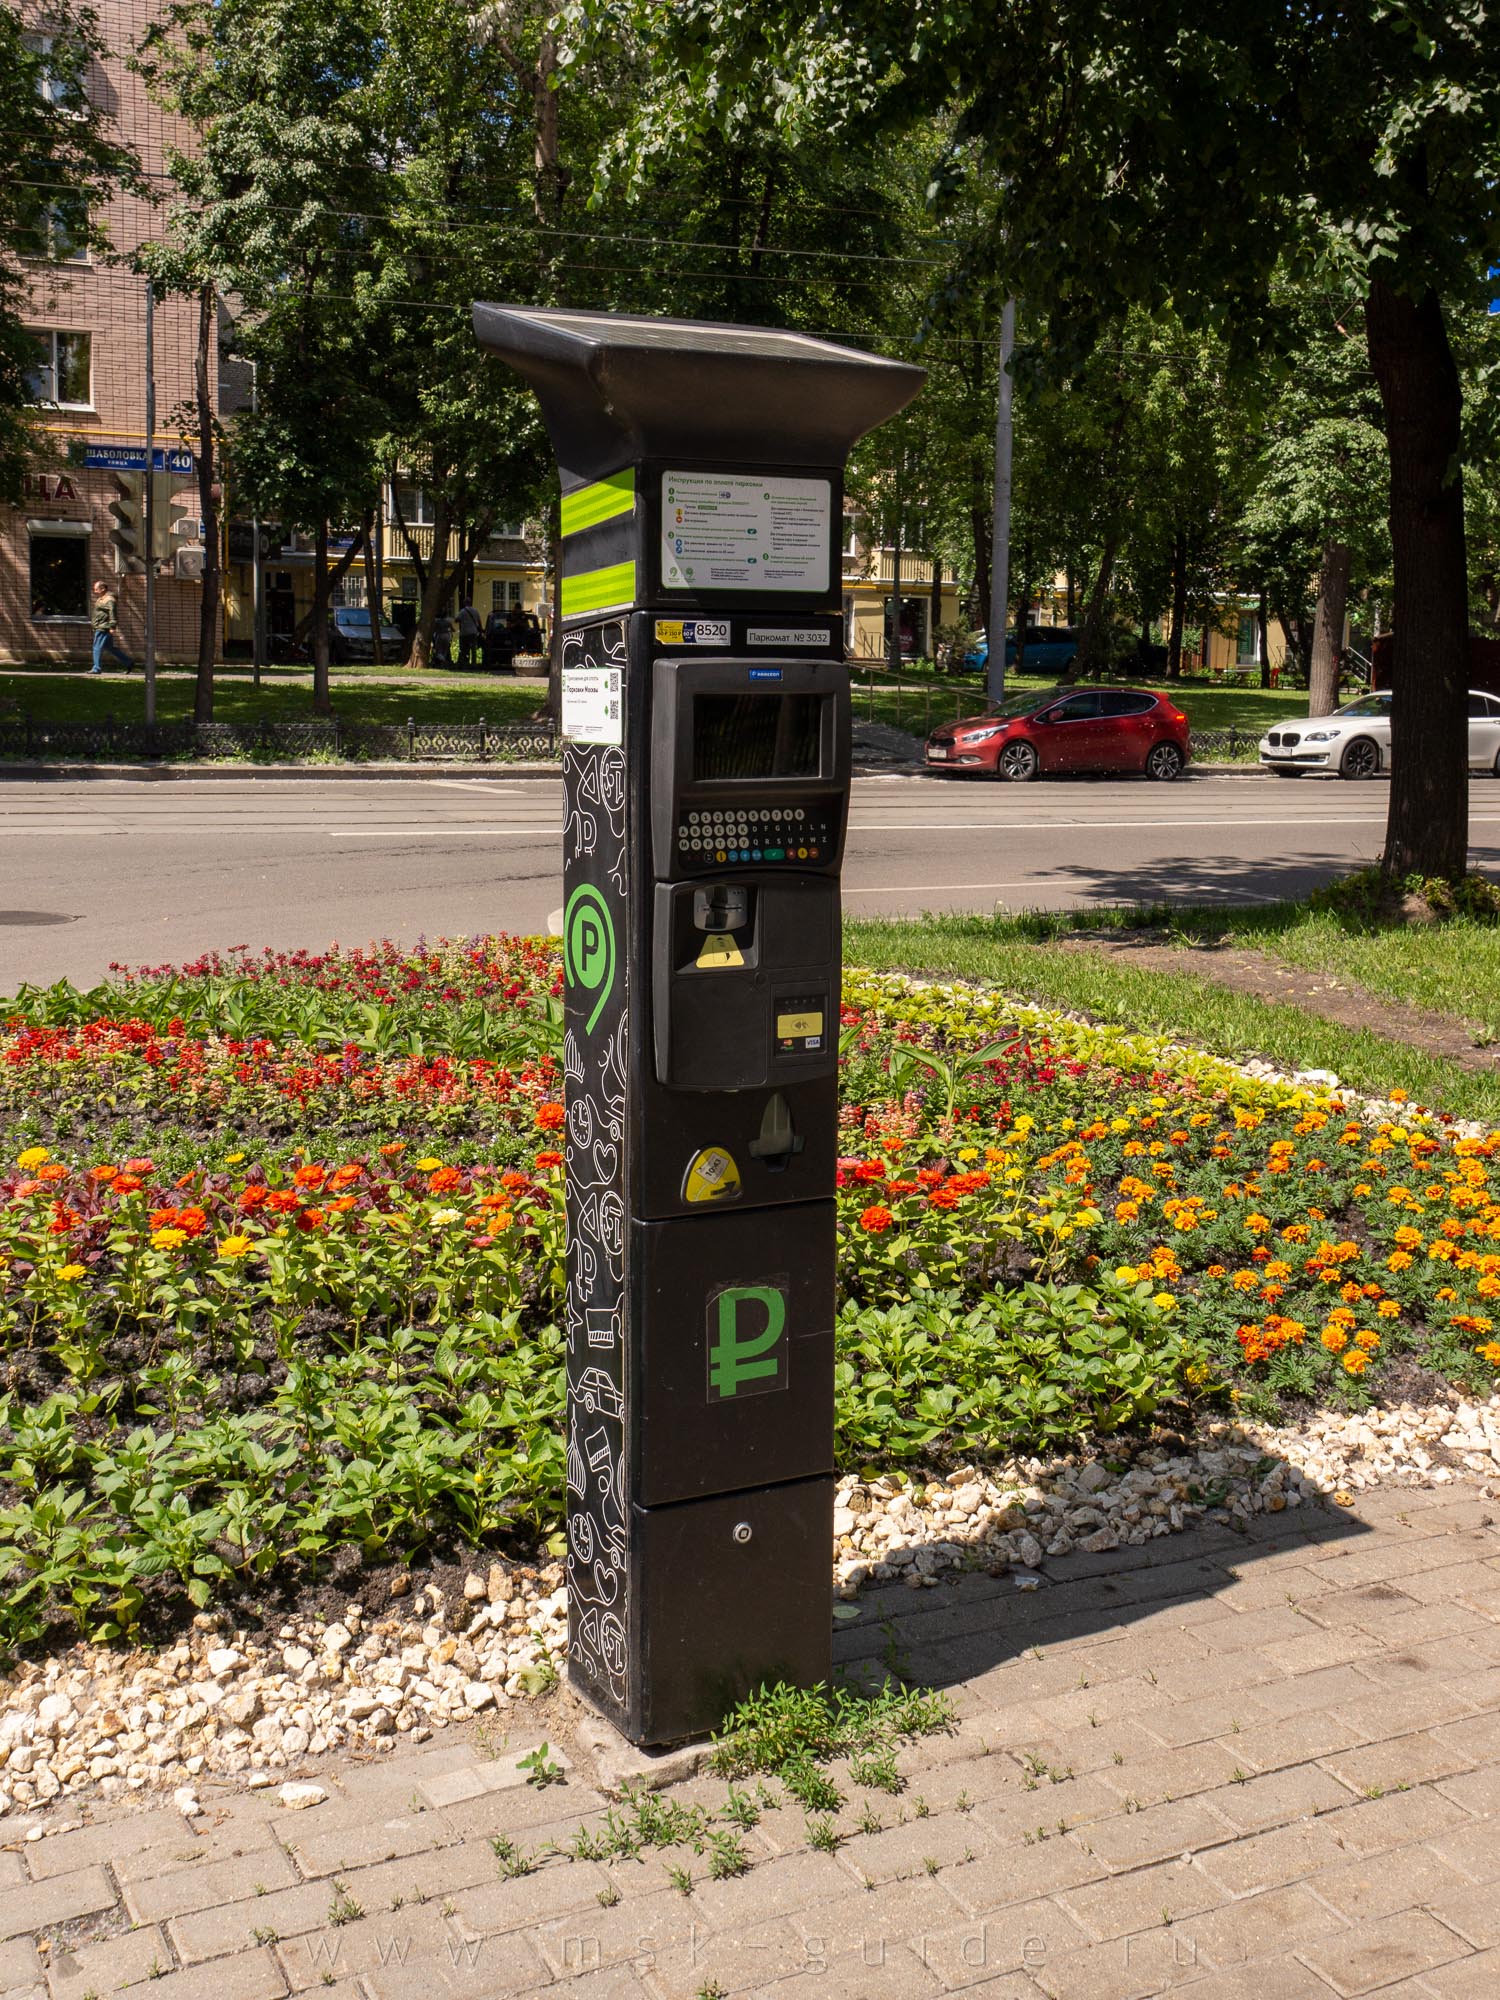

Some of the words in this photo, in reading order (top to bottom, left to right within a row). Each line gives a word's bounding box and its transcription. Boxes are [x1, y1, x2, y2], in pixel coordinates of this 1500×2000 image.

[86, 448, 148, 460] ШАБОЛОВКА
[172, 456, 190, 468] 40
[668, 476, 704, 485] Инструкция
[696, 624, 727, 636] 8520
[750, 632, 790, 643] Паркомат
[794, 633, 804, 642] №
[806, 634, 827, 642] 3032
[567, 686, 584, 694] Парковки
[581, 919, 599, 972] P
